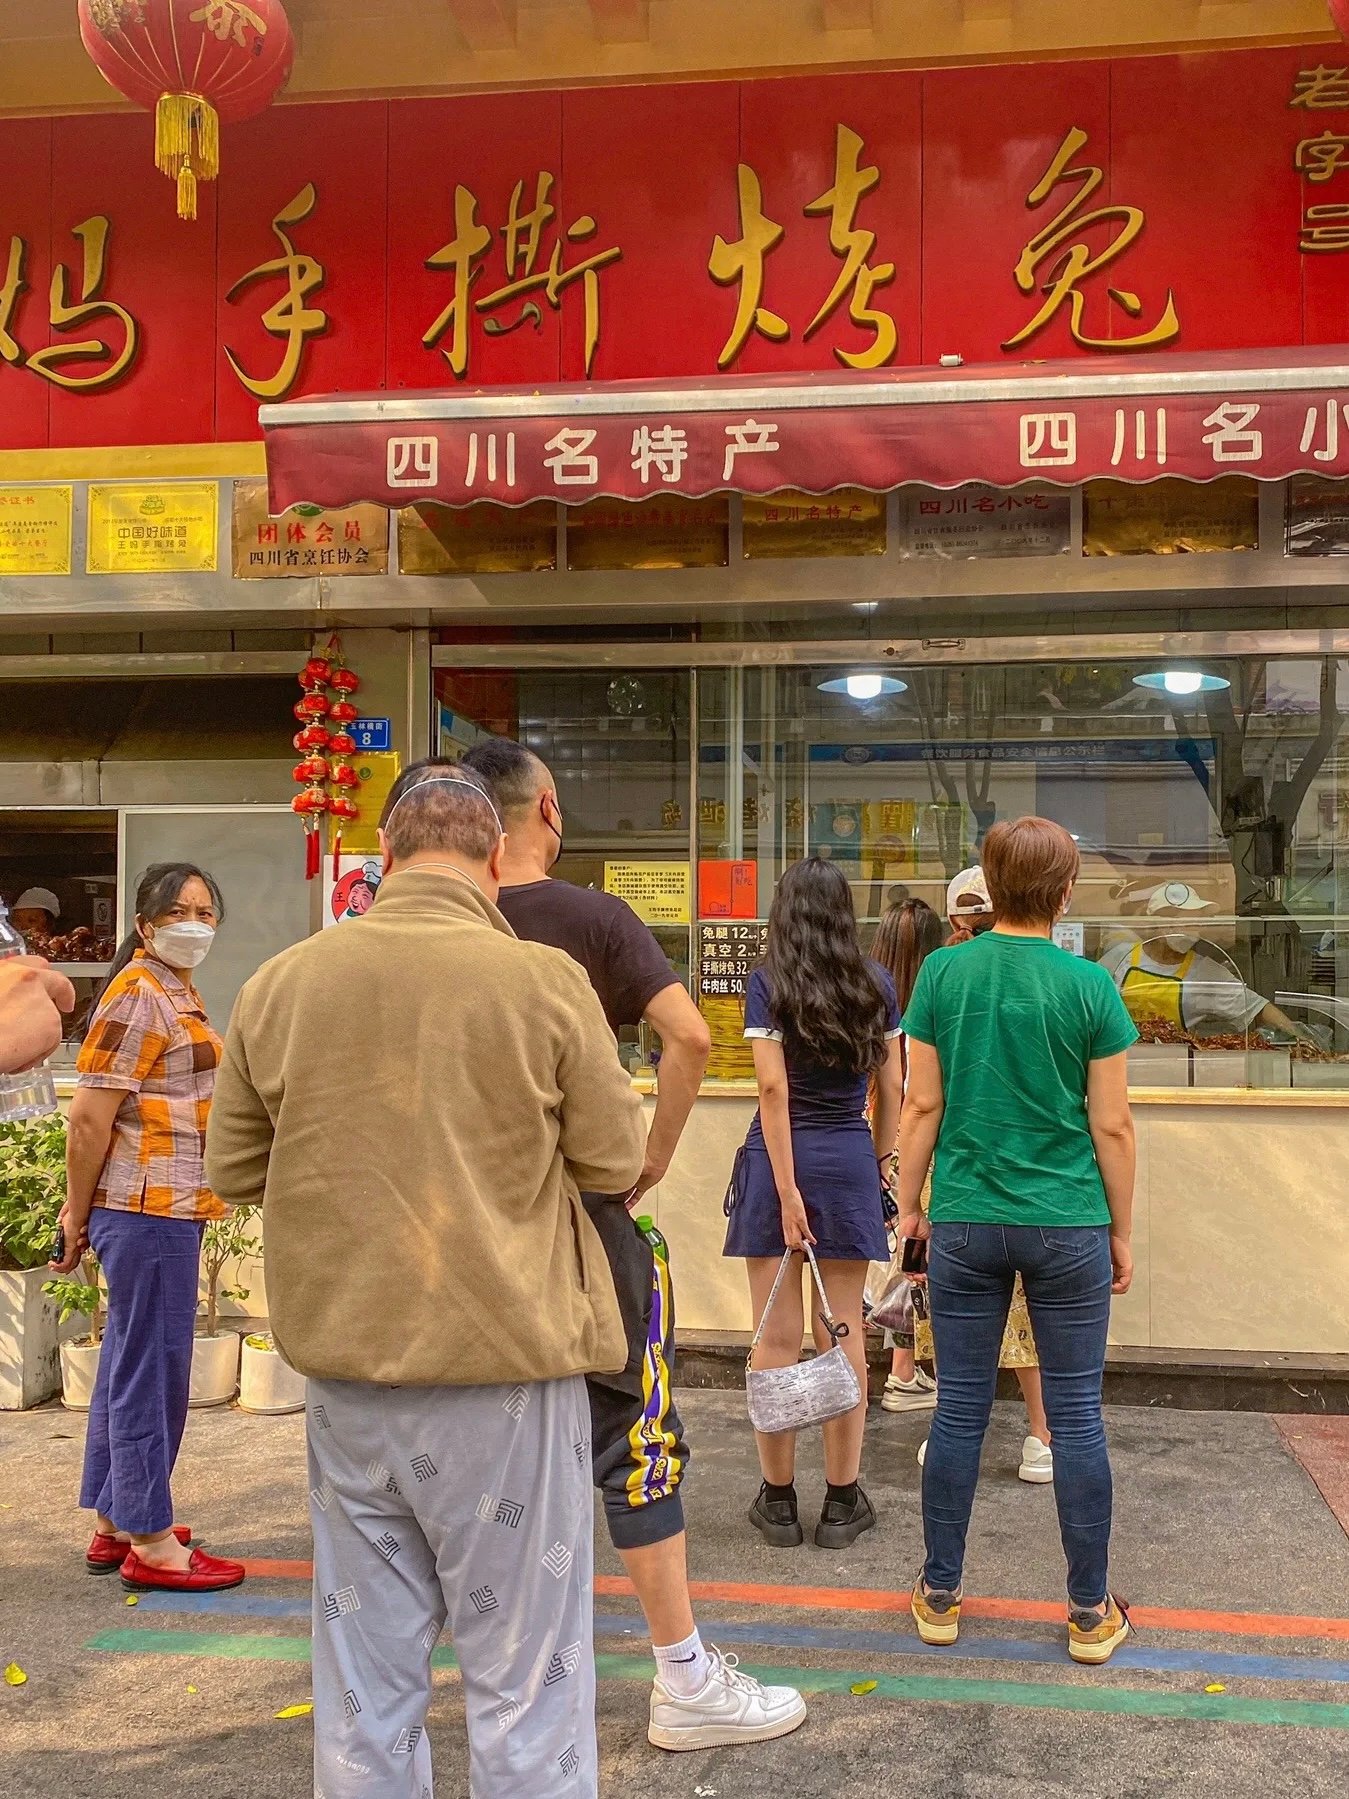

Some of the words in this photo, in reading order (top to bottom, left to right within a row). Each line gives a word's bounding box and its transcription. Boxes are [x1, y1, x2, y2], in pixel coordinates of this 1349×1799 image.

[1289, 64, 1349, 253] 老字号
[1019, 399, 1349, 468] 四川名小
[386, 418, 780, 488] 四川名特产
[765, 503, 863, 522] 四川名特产
[919, 494, 1049, 515] 四川名小吃
[117, 525, 188, 539] 中国好味道
[258, 521, 362, 545] 团体会员
[250, 547, 369, 566] 四川省烹饪协会
[362, 732, 371, 746] 8
[335, 892, 346, 903] 王
[702, 943, 732, 957] 真空
[702, 961, 736, 976] 手撕烤兔
[702, 978, 729, 994] 牛肉丝
